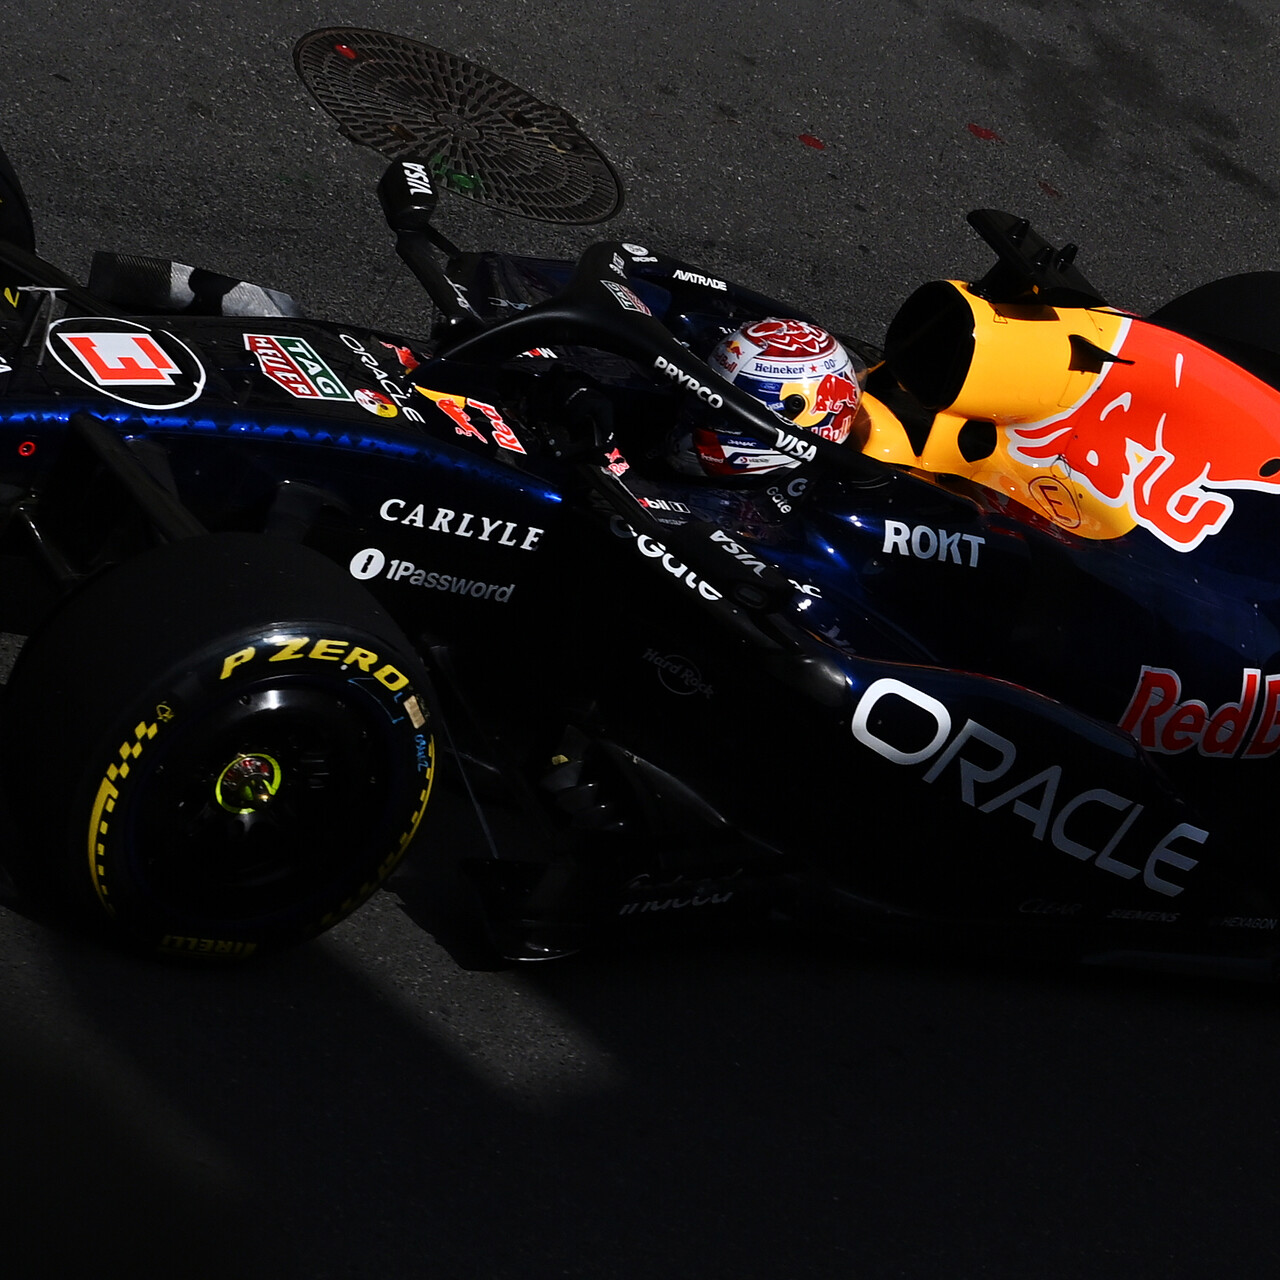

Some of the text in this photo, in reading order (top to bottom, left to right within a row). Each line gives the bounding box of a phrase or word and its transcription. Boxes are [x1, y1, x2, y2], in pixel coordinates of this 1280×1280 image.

[402, 162, 434, 196] VISA
[672, 269, 728, 292] AVATRADE
[282, 337, 341, 396] TAG
[338, 333, 425, 425] ORACLE
[654, 355, 724, 408] PRYPCO
[754, 362, 805, 375] Heineken
[775, 428, 818, 462] VISA
[766, 485, 792, 515] Gate
[379, 498, 547, 552] CARLYLE
[882, 519, 986, 568] ROKT
[709, 529, 768, 578] VISA
[385, 557, 516, 604] 1Password
[219, 636, 411, 693] P ZERO
[1117, 664, 1262, 759] Red
[851, 677, 1210, 898] ORACLE
